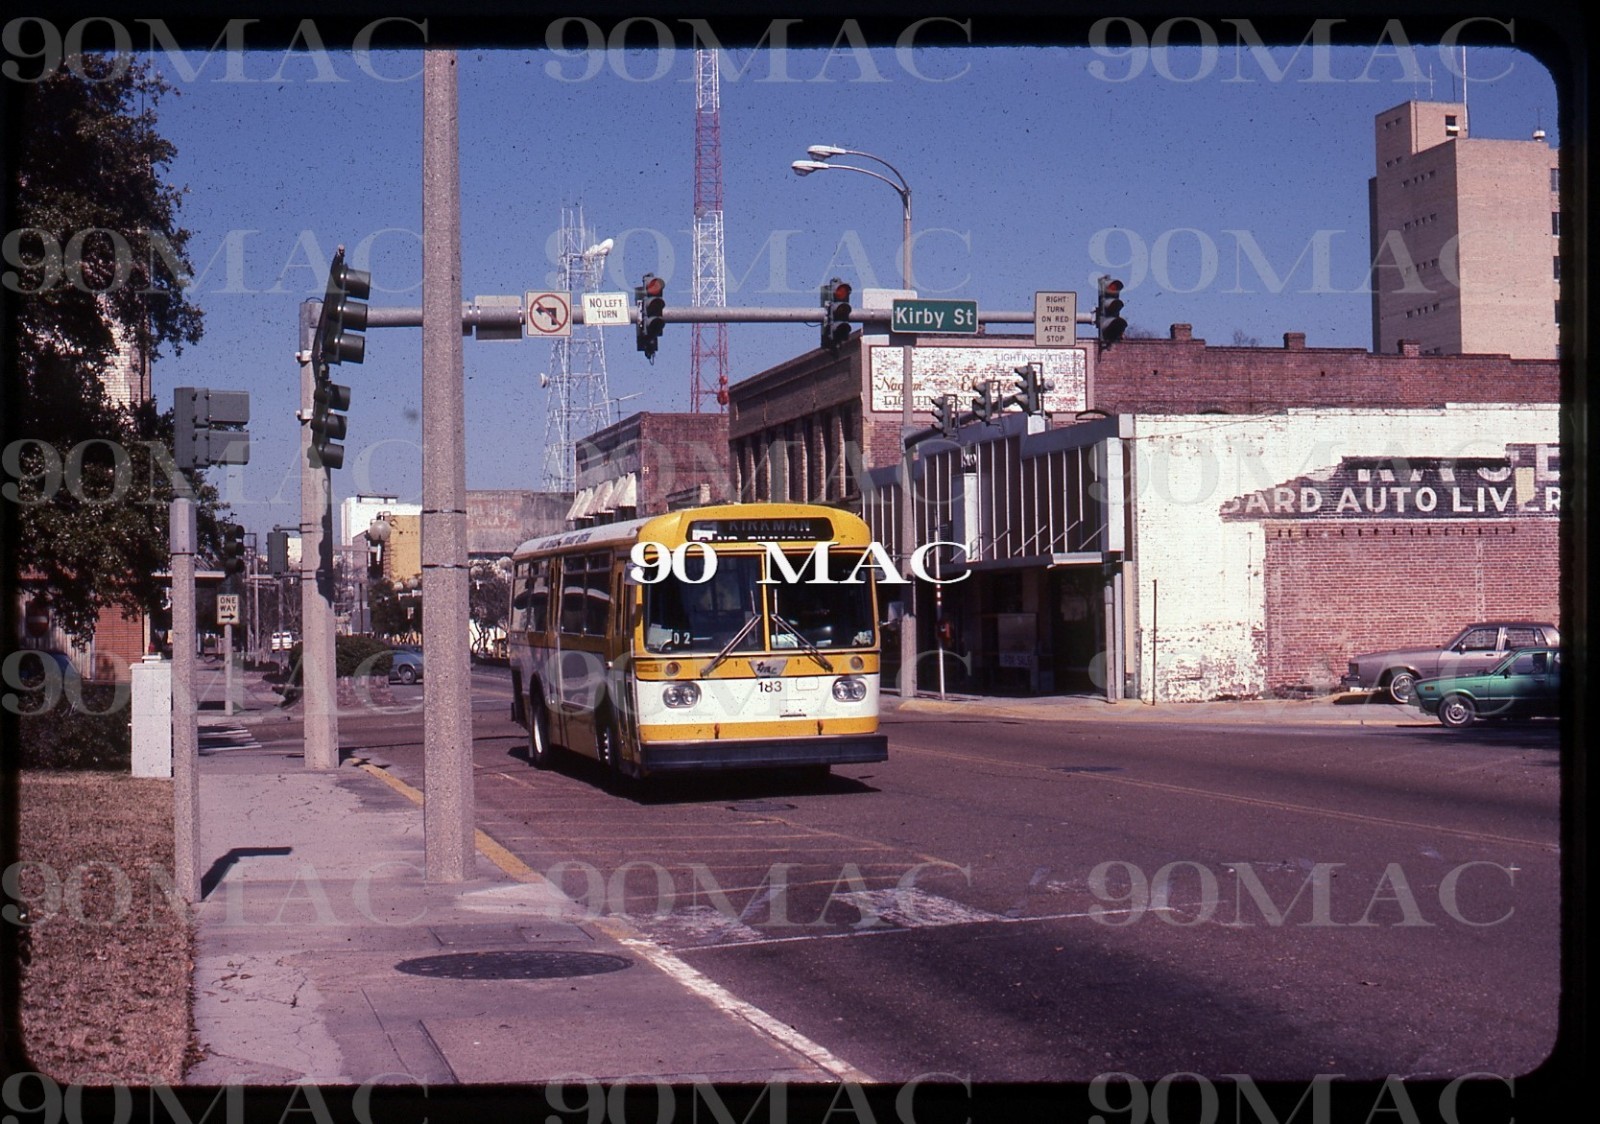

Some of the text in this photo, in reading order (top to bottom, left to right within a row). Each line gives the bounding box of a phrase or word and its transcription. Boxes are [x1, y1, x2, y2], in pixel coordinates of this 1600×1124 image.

[589, 298, 622, 308] NO LEFT
[597, 310, 618, 318] TURN
[895, 307, 974, 329] Kirby St
[1041, 315, 1069, 323] ON RED
[1043, 325, 1066, 333] AFTER
[1046, 335, 1065, 343] STOP
[1335, 486, 1438, 513] AUTO
[220, 596, 237, 604] ONE
[757, 680, 782, 693] 183
